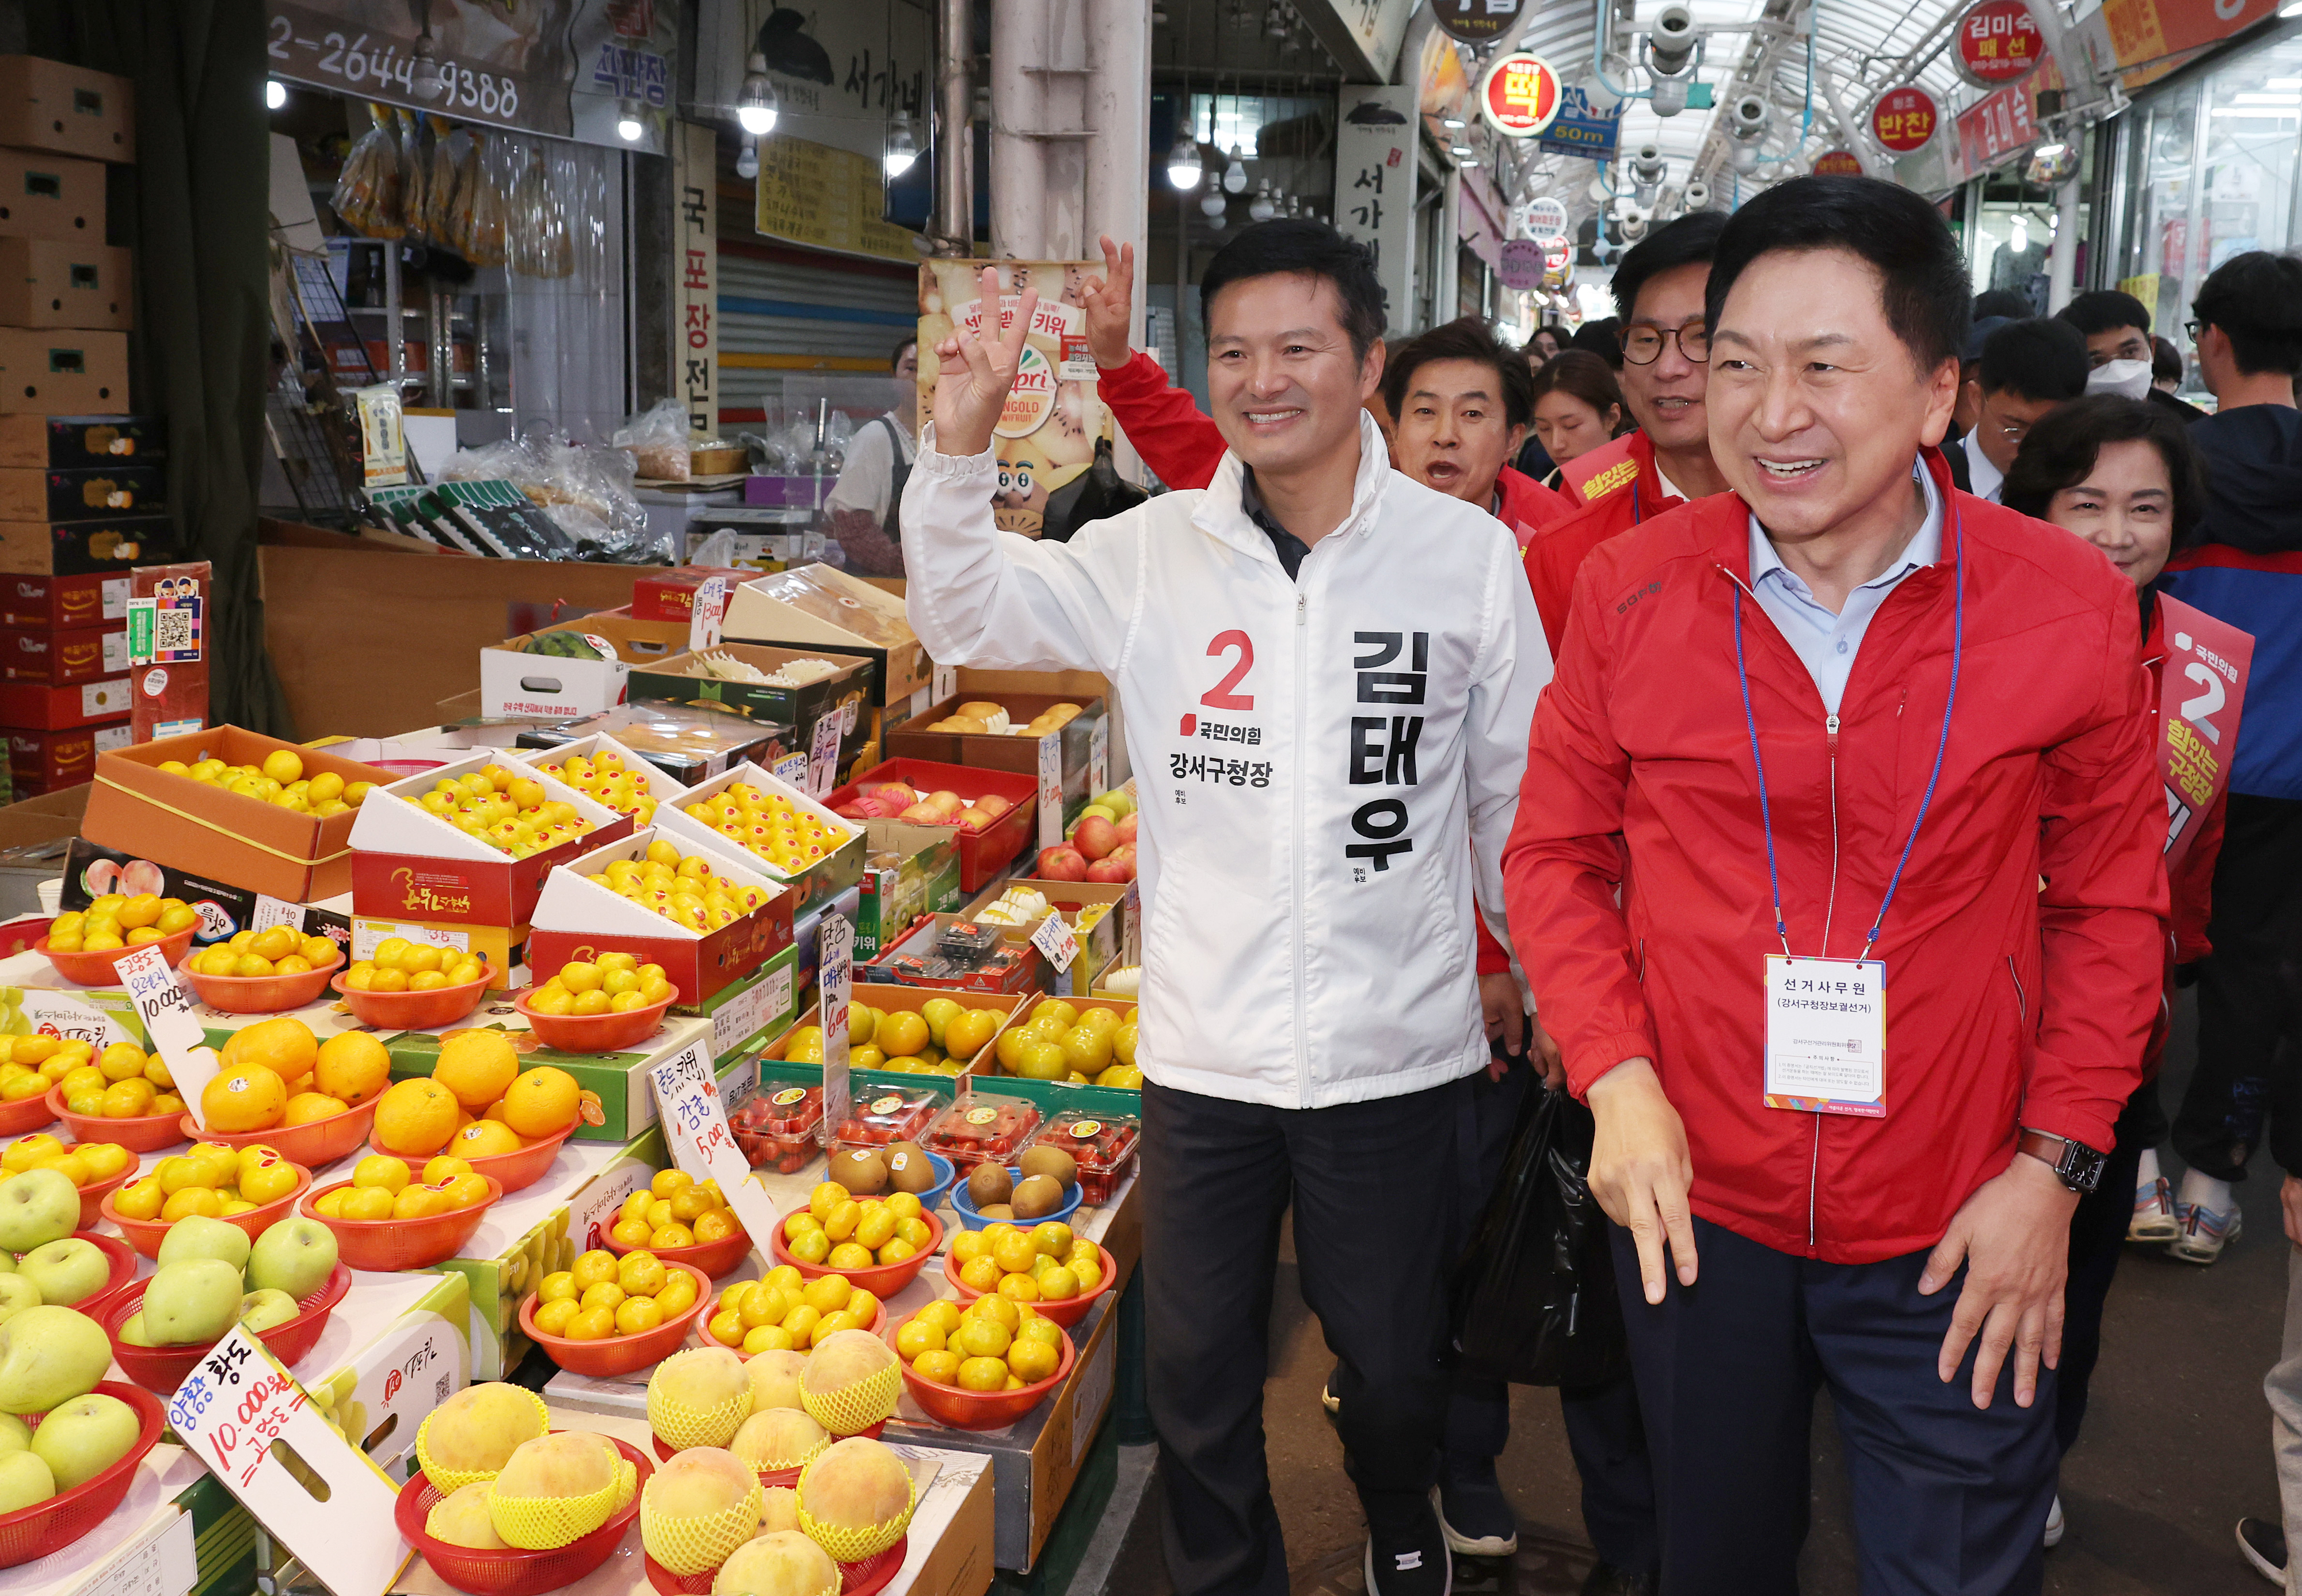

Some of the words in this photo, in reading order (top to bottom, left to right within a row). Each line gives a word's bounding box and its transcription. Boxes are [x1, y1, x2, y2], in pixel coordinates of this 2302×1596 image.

[1970, 13, 2036, 39] 김미숙
[268, 16, 518, 117] 2-26449388
[593, 43, 666, 108] 직판장
[844, 48, 922, 119] 서가네
[1504, 73, 1541, 117] 떡
[1555, 125, 1604, 144] 50m
[1879, 111, 1931, 140] 반찬
[1034, 313, 1066, 337] 키위
[1003, 401, 1039, 413] NGOLD
[1200, 630, 1255, 711] 2
[2196, 644, 2238, 684] 국민의힘
[2181, 662, 2225, 745] 2
[1200, 722, 1261, 745] 국민의힘
[2167, 719, 2219, 781] 힘있는
[1346, 631, 1429, 872] 김태우
[1169, 753, 1273, 788] 강서구청장
[2167, 749, 2214, 806] 구청장
[1175, 789, 1186, 797] 예비
[1175, 797, 1187, 805] 후보
[1353, 867, 1366, 875] 예비
[824, 917, 845, 952] 단감
[853, 936, 875, 951] 키위
[124, 952, 154, 975] 고당도
[132, 967, 169, 998] 오렌지
[1784, 978, 1865, 995] 선거사무원
[1778, 998, 1872, 1014] (강서구청장보궐선거)
[676, 1049, 698, 1076] 키위
[677, 1095, 710, 1130] 감귤
[207, 1339, 251, 1385] 황도
[246, 1406, 289, 1464] 고당도
